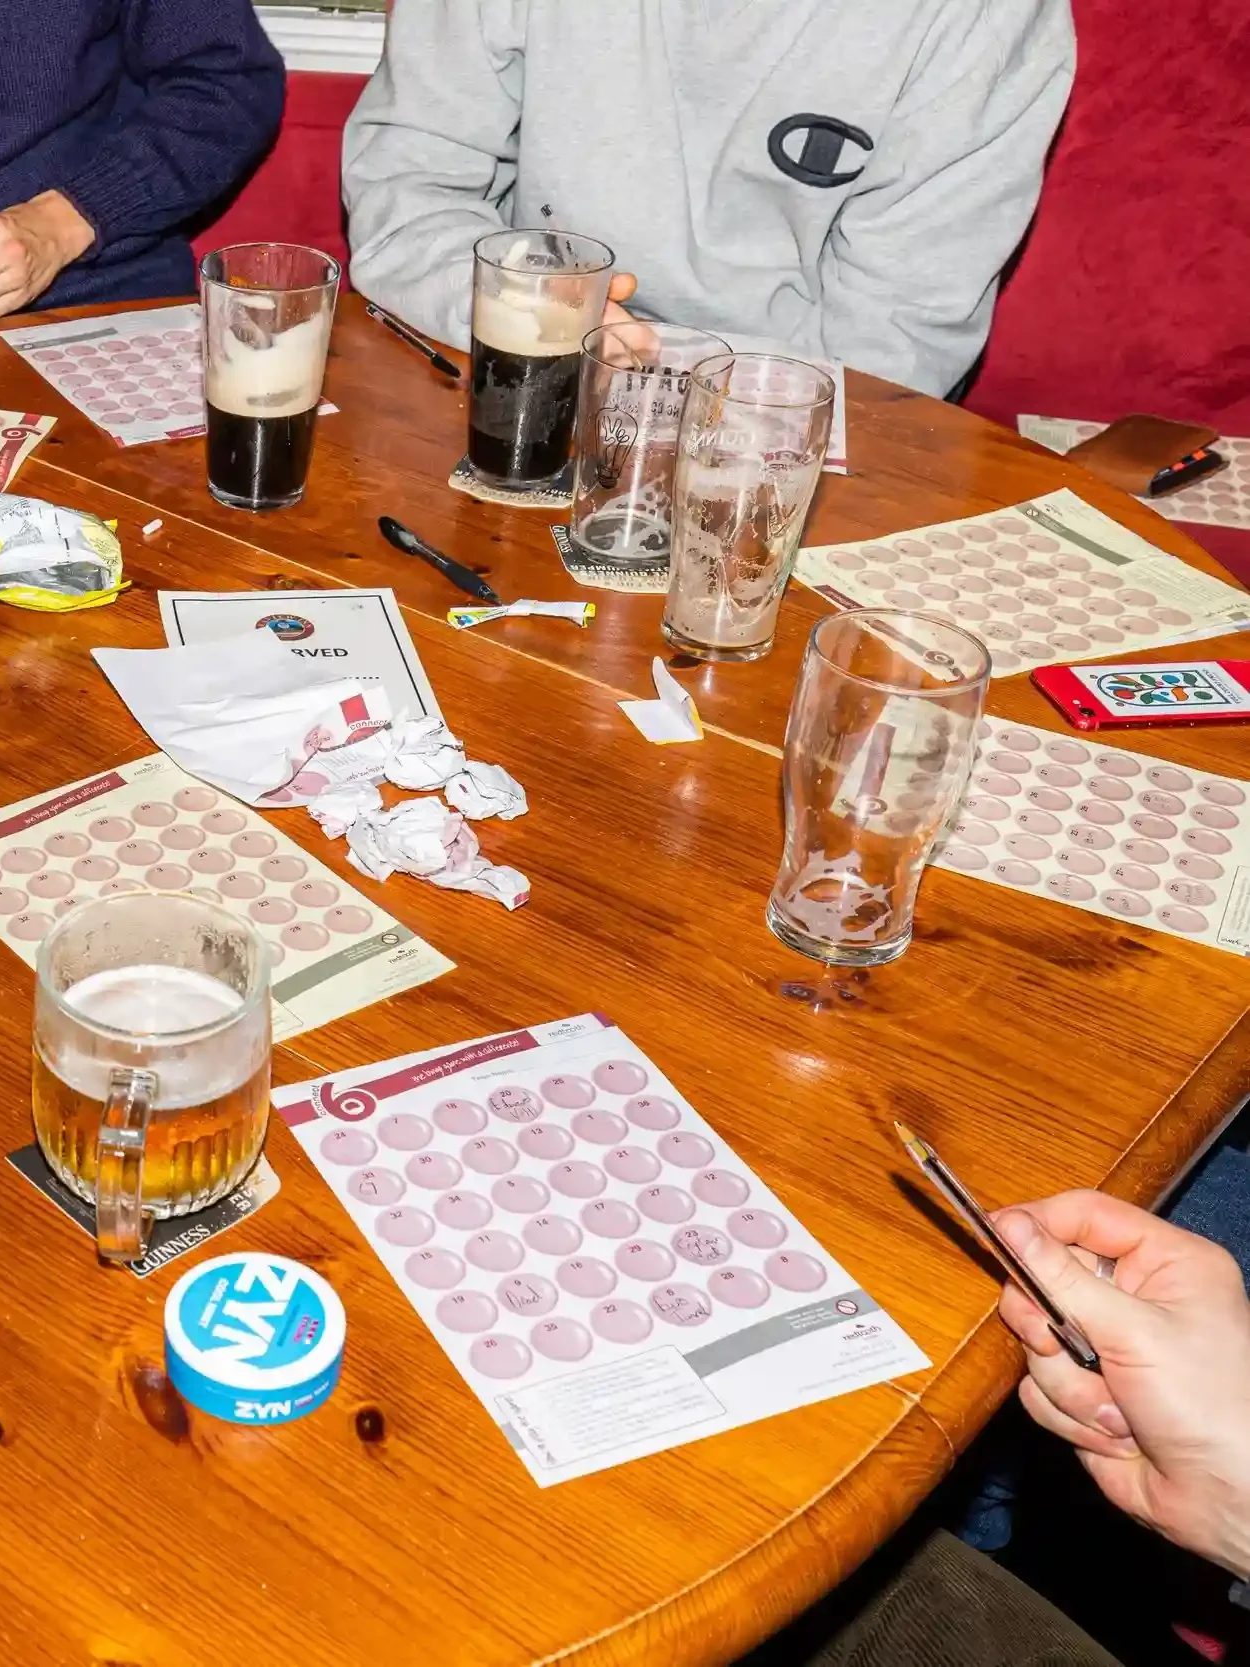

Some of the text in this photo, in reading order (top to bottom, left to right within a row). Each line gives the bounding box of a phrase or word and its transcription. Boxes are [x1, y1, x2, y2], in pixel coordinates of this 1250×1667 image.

[291, 648, 349, 657] RVED
[131, 1223, 211, 1272] GUINNESS
[234, 1400, 292, 1419] ZYN
